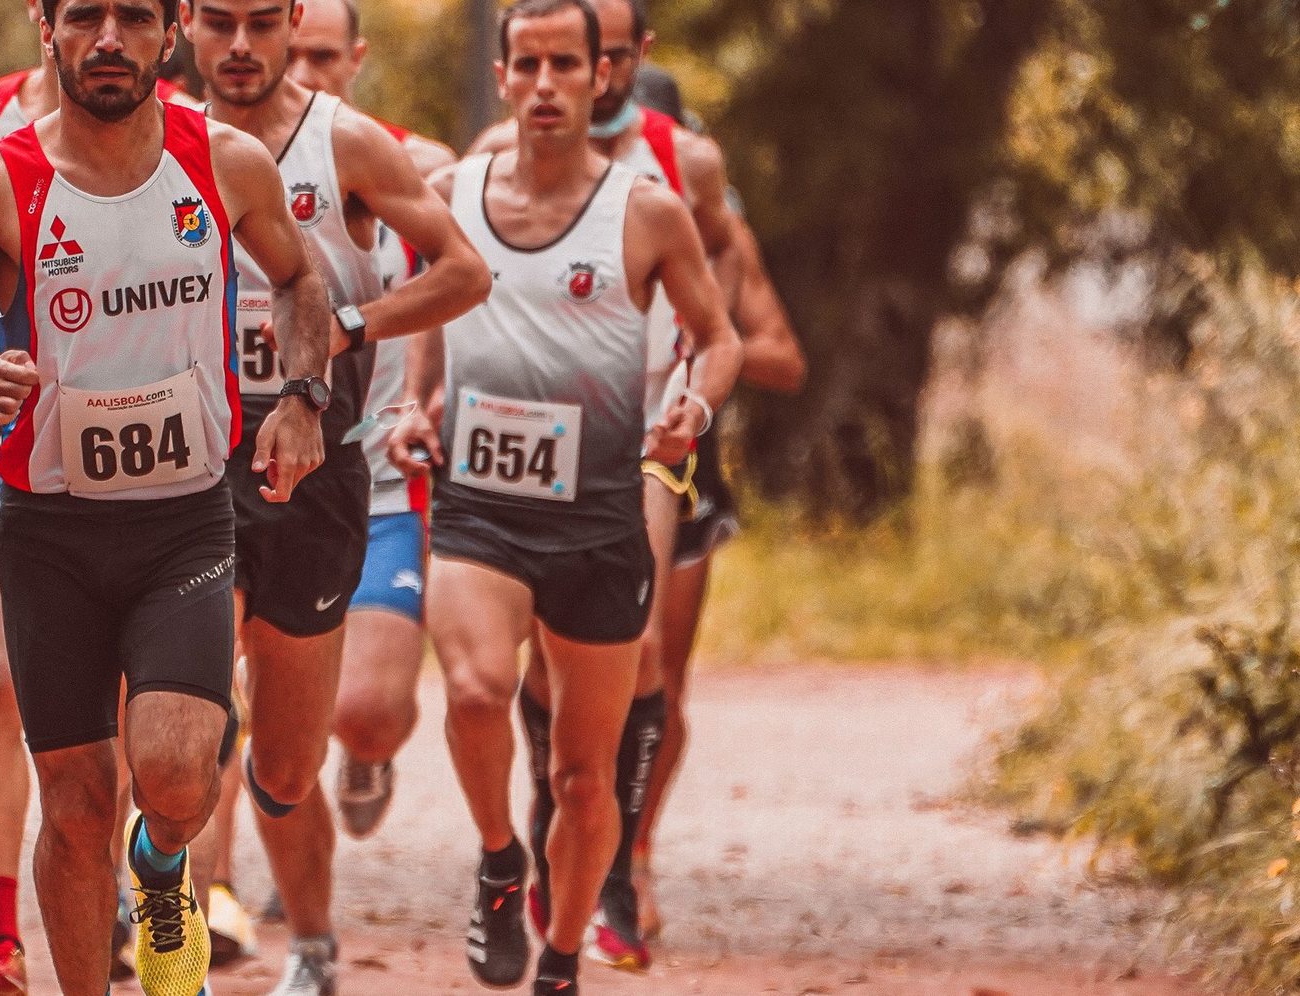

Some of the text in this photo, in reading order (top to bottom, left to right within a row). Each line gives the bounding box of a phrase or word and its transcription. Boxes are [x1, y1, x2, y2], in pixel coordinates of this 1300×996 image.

[41, 255, 84, 269] MITSUBISHI
[48, 265, 80, 277] MOTORS
[102, 273, 212, 316] UNIVEX
[87, 390, 166, 407] AALISBOA.com
[81, 413, 190, 481] 684
[469, 427, 557, 488] 654
